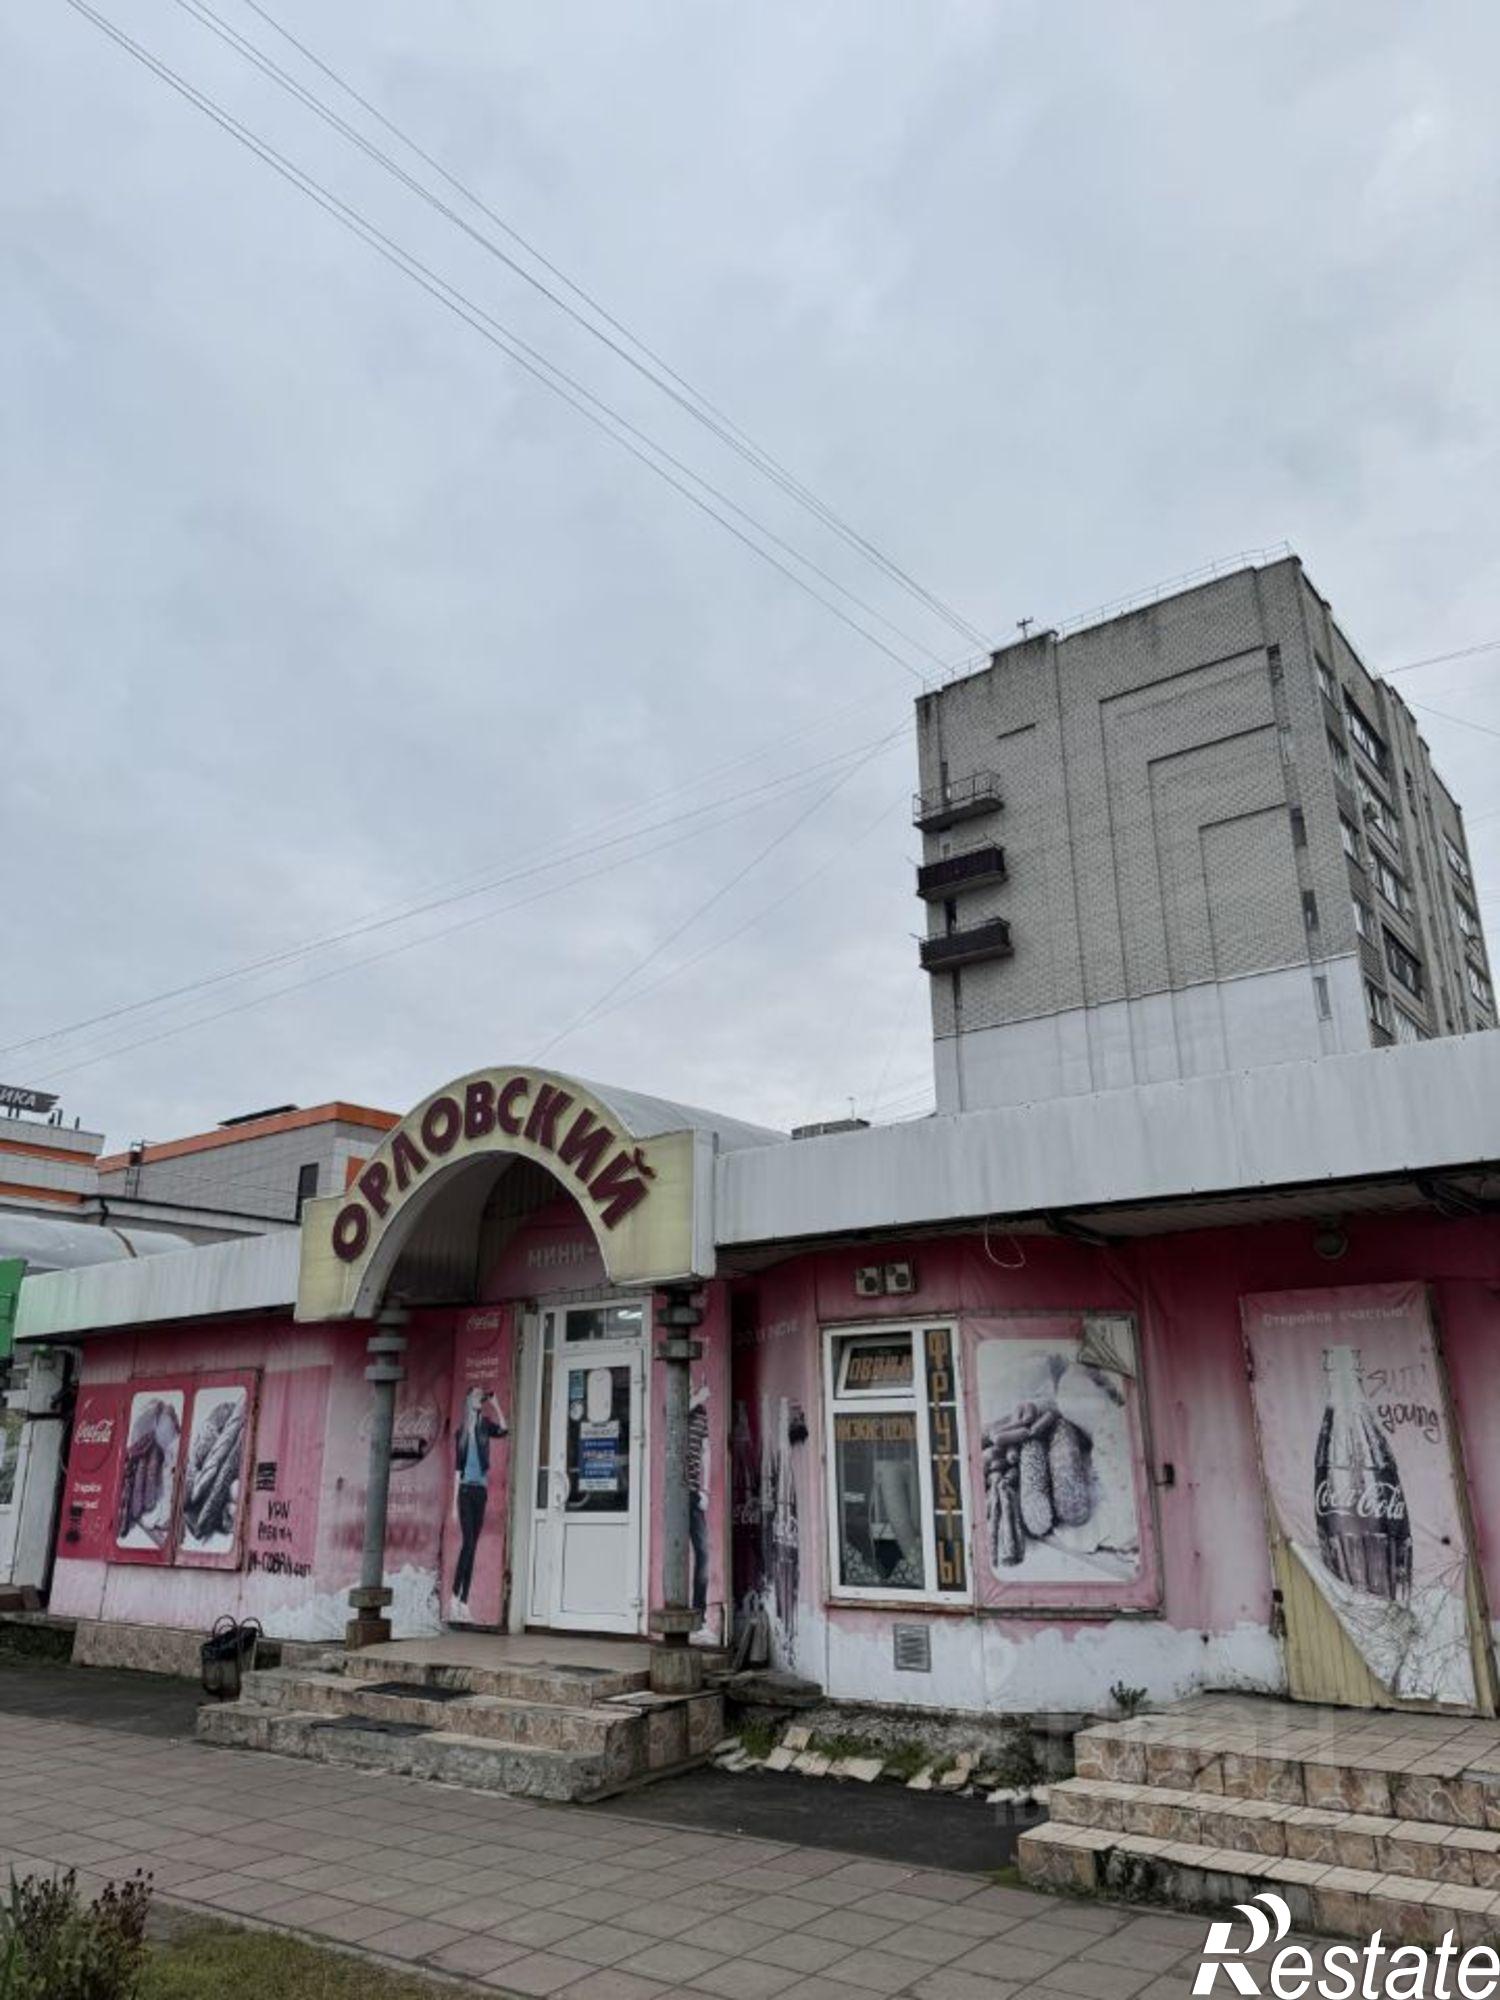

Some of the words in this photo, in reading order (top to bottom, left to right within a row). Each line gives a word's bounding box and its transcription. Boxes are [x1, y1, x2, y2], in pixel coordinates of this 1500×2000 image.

[332, 1077, 656, 1262] ОРЛОВСКИЙ
[928, 1330, 962, 1584] ФРУКТЫ
[1378, 1403, 1441, 1444] young
